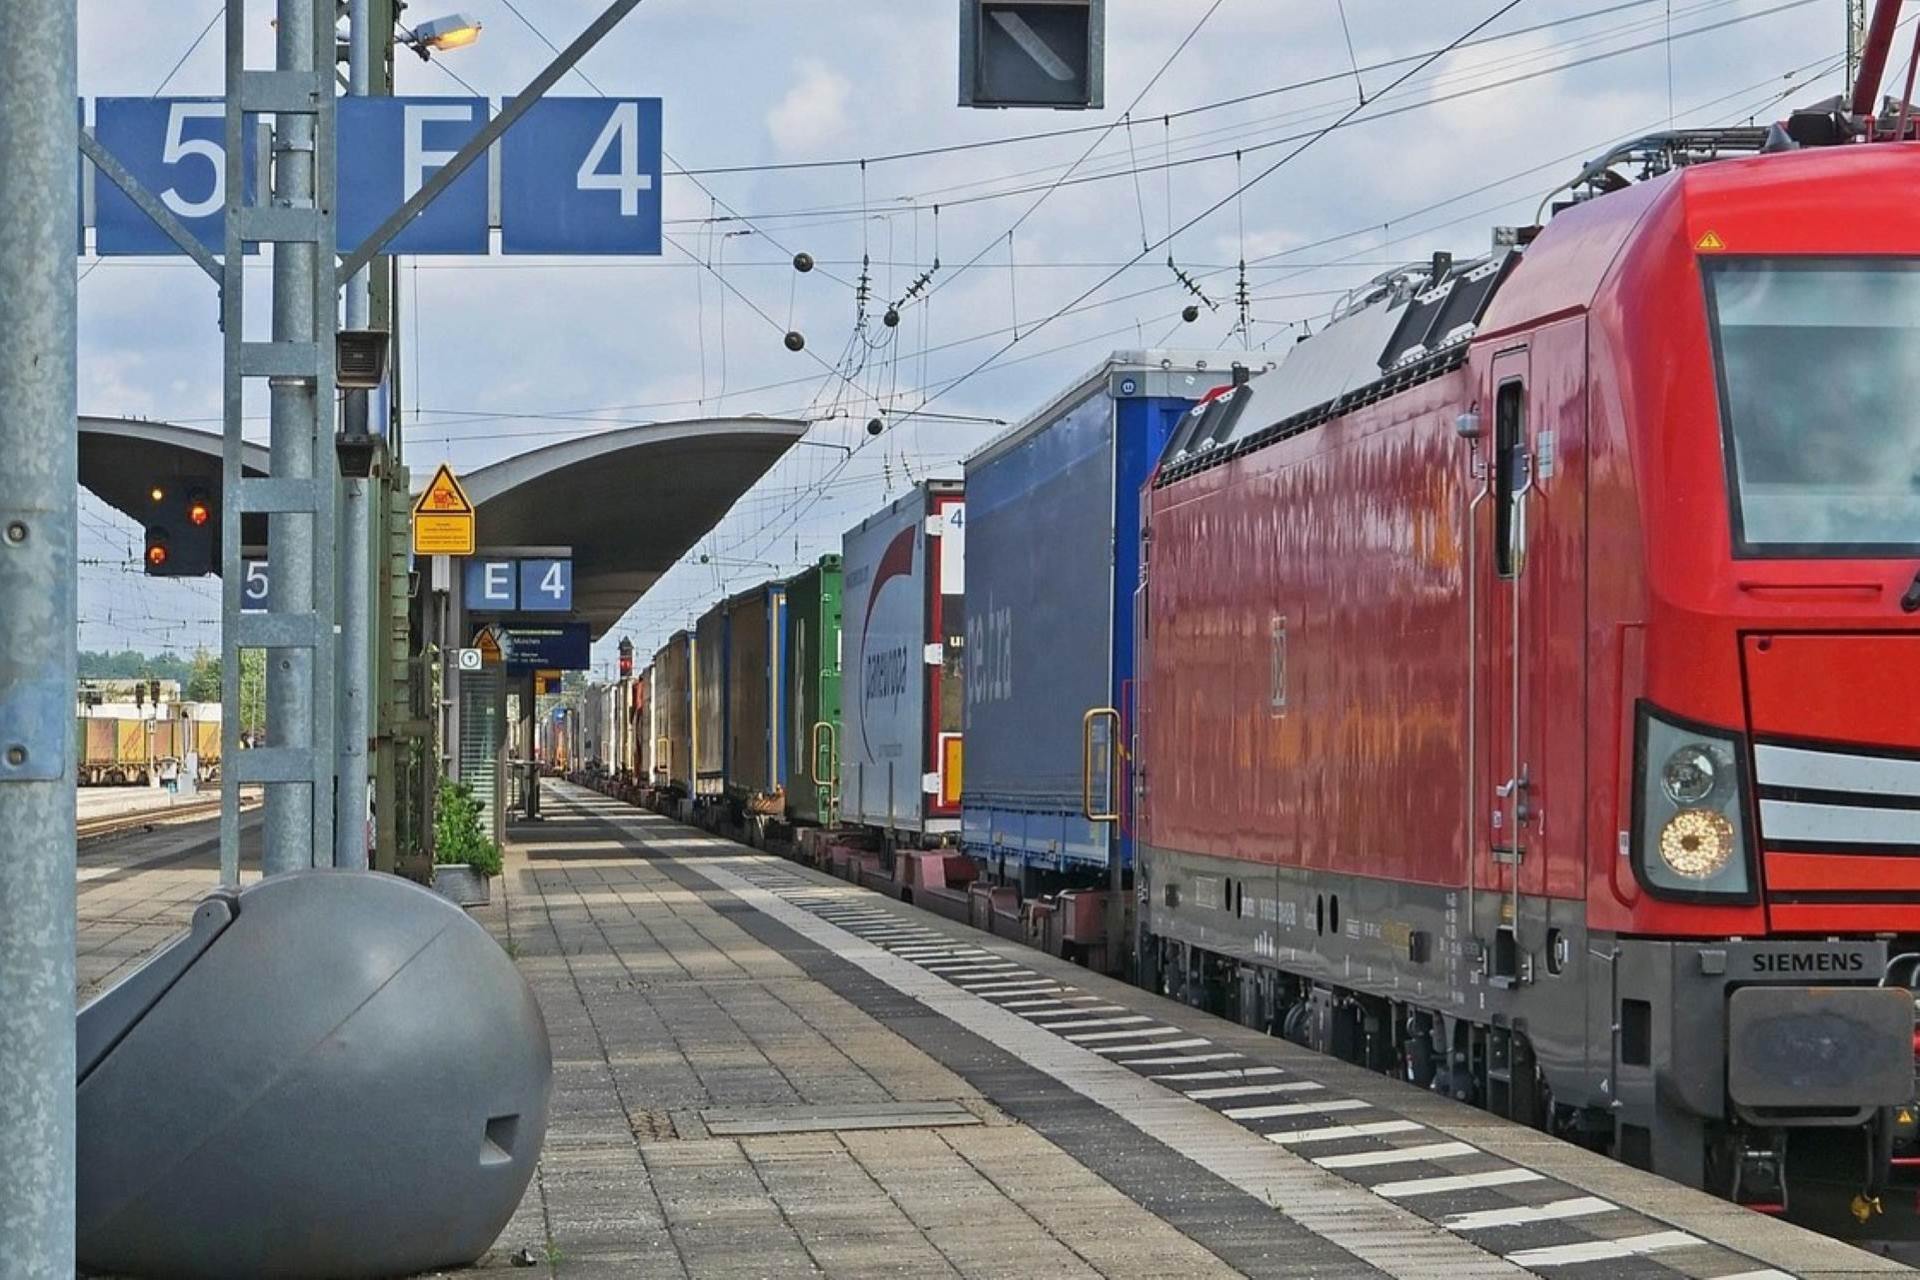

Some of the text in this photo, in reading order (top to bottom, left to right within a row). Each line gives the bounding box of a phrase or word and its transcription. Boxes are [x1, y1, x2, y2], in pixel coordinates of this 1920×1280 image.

[160, 102, 226, 218] 5
[576, 102, 652, 216] 4
[245, 561, 269, 599] 5
[484, 562, 566, 599] E 4
[1753, 952, 1864, 973] SIEMENS
